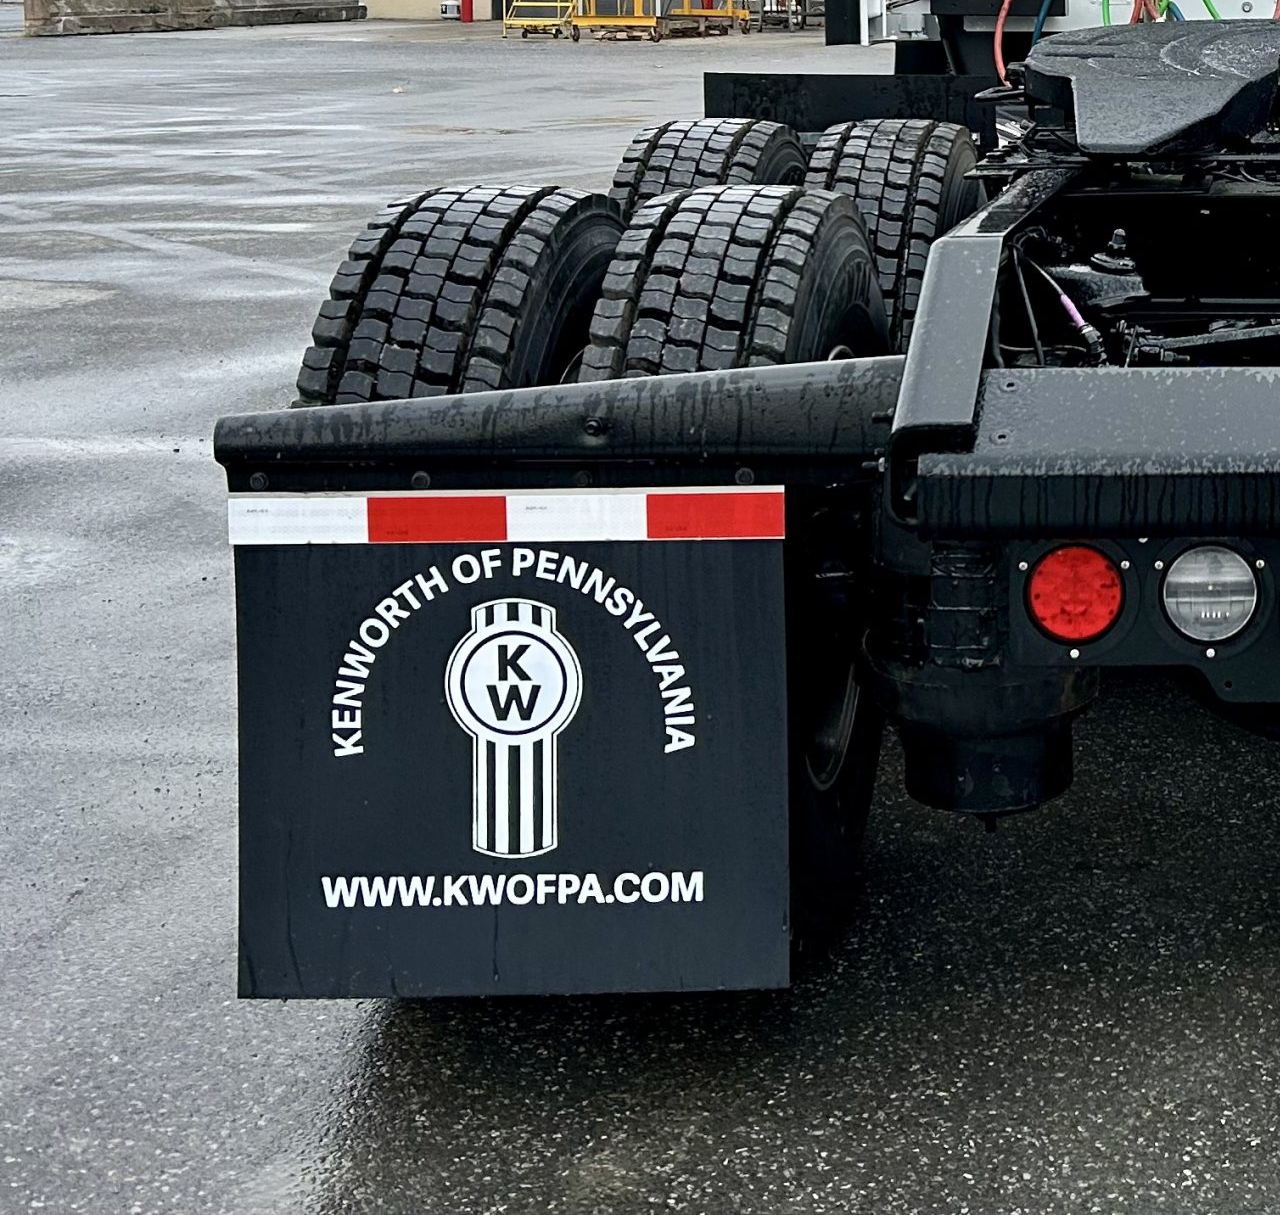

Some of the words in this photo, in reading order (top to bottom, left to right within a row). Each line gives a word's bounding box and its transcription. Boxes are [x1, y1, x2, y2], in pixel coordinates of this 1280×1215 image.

[332, 565, 449, 757] KENWORTH
[451, 548, 502, 584] OF
[512, 547, 696, 754] PENNSYLVANIA
[497, 644, 532, 682] K
[486, 684, 542, 722] W
[321, 871, 704, 908] WWW.KWOFPA.COM
